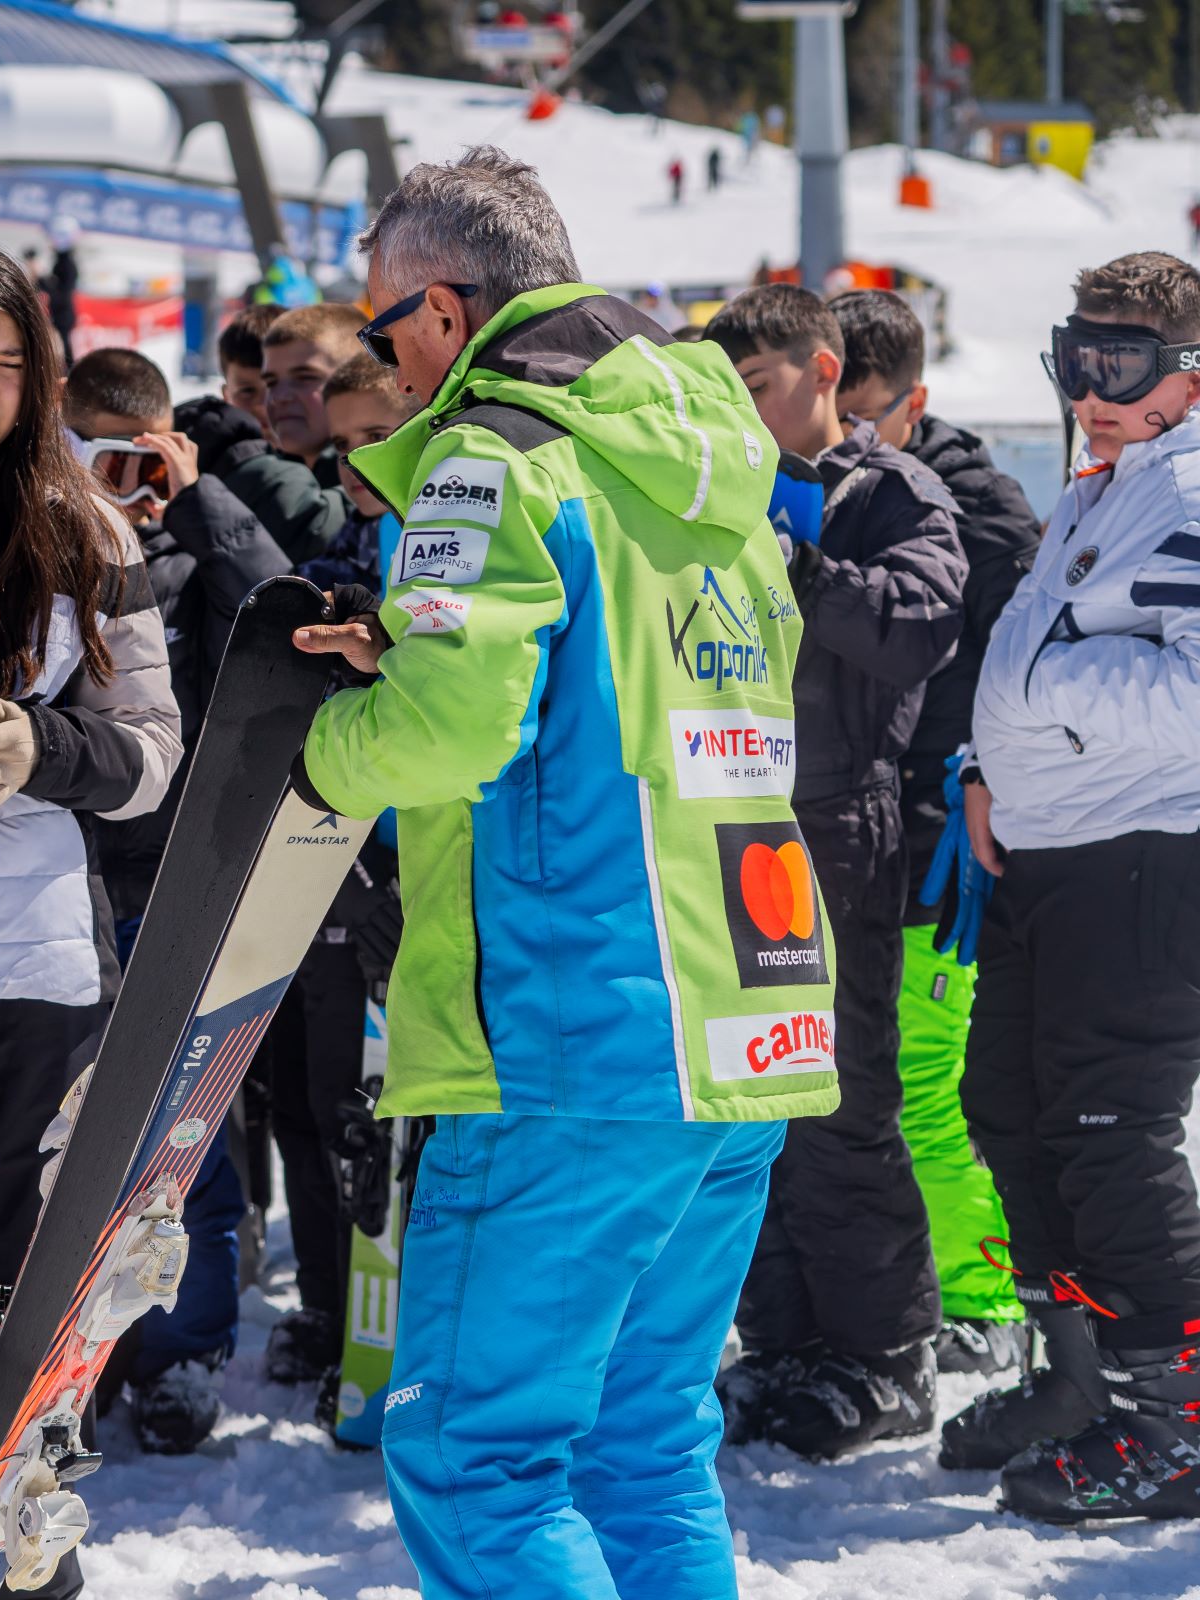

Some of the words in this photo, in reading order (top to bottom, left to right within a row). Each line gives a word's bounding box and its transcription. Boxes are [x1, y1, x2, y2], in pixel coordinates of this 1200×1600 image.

[417, 482, 497, 504] OCCER
[411, 541, 460, 561] AMS
[409, 556, 473, 571] OSIGURANJE
[724, 768, 740, 778] THE
[744, 767, 772, 778] HEART
[286, 836, 350, 846] DYNASTAR
[757, 944, 820, 967] mastercard
[182, 1034, 212, 1072] 149
